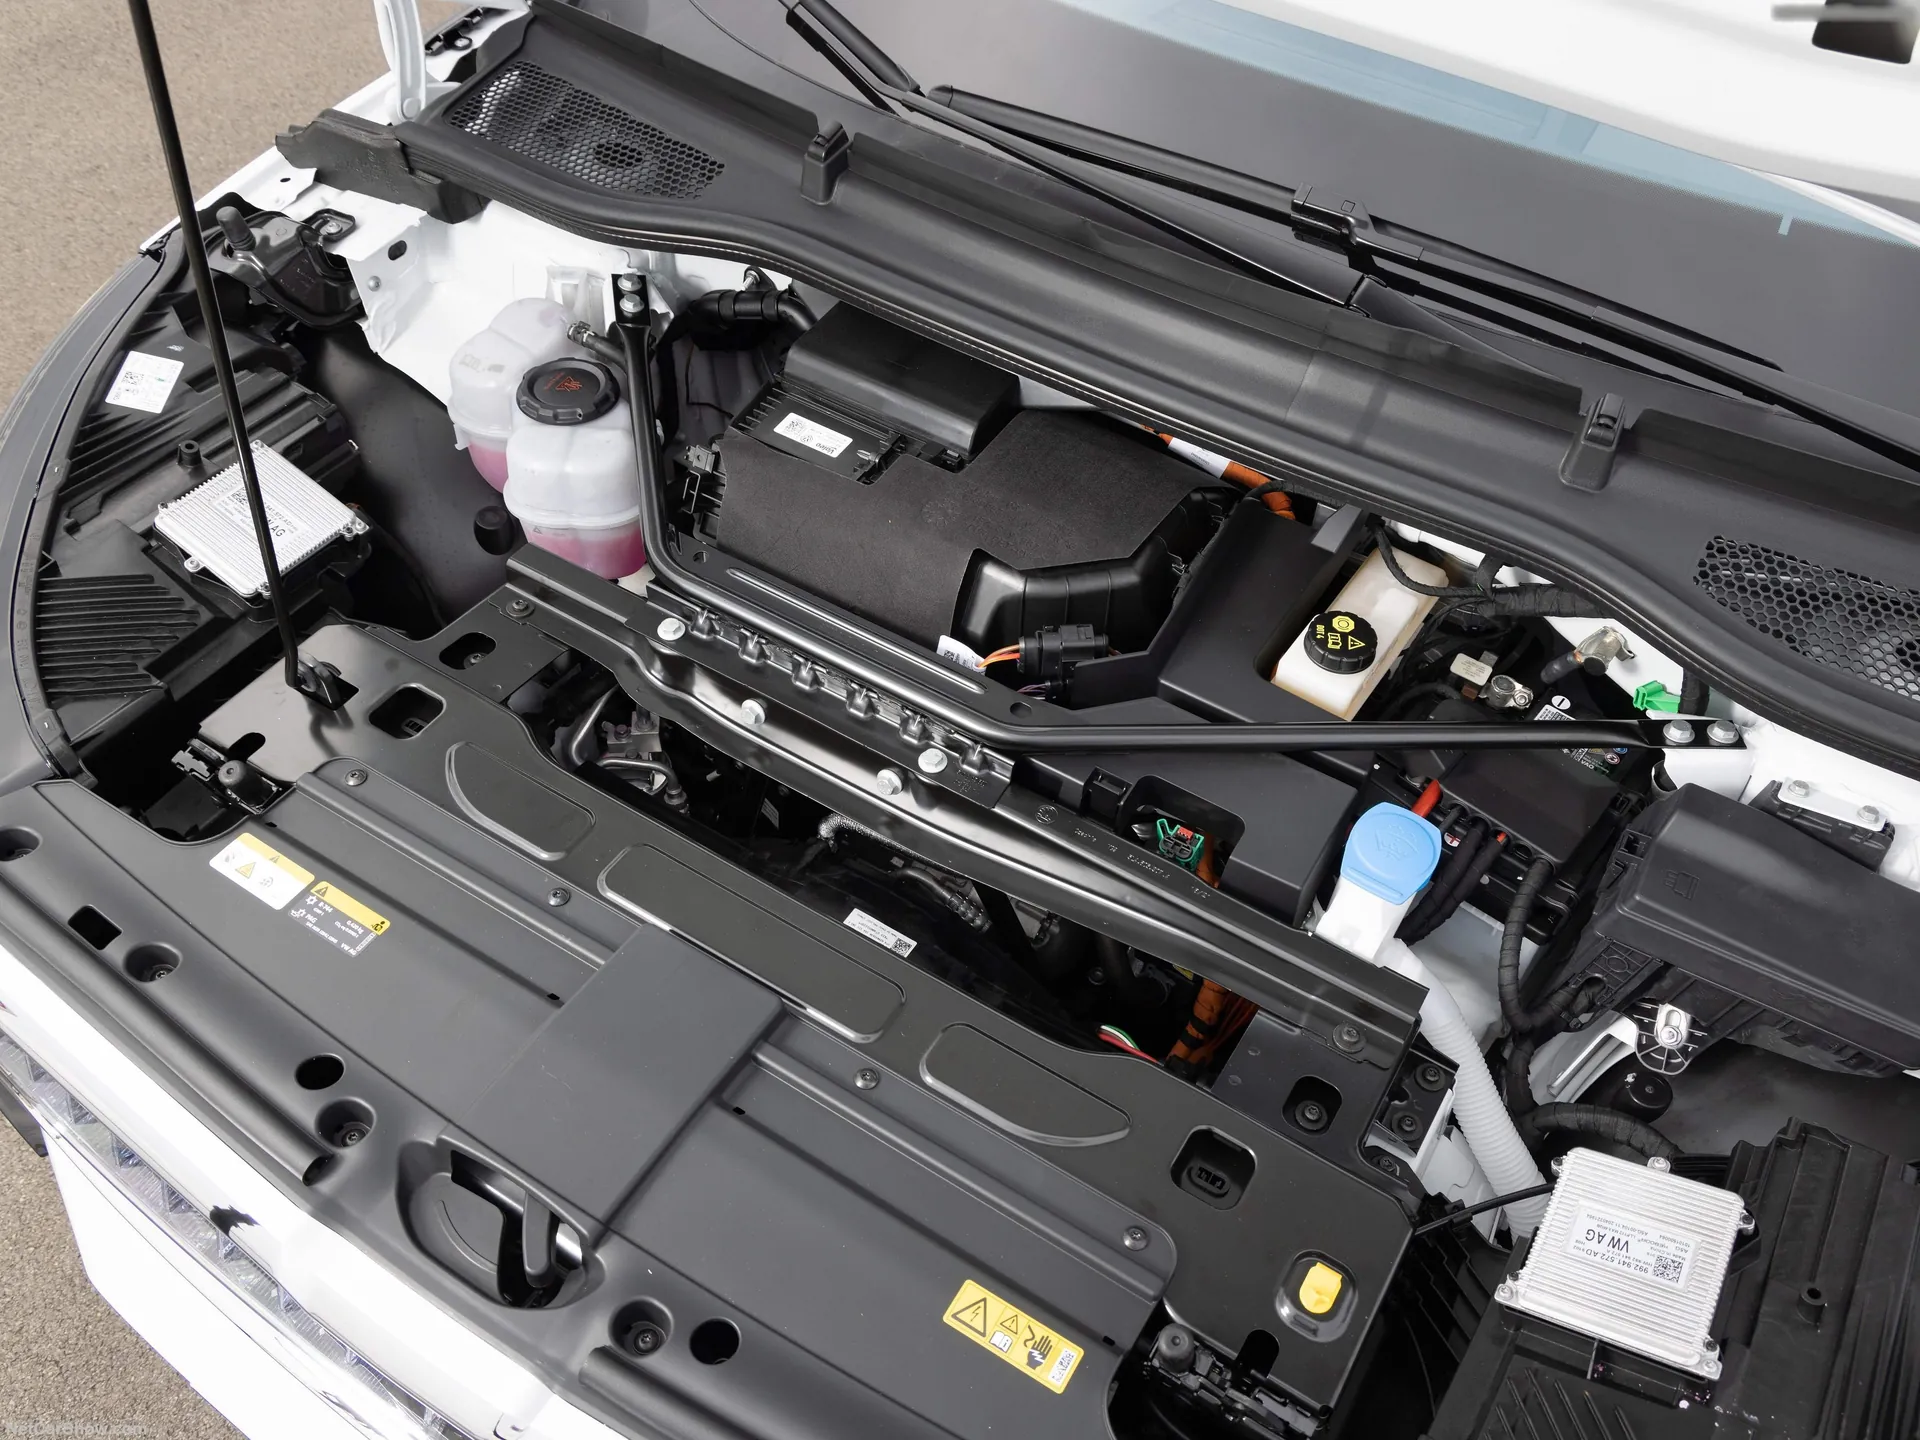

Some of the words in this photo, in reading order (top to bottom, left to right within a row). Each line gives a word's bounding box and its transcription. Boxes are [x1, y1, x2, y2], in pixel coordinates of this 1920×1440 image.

[270, 525, 286, 537] AG
[1316, 624, 1325, 635] DOT
[318, 902, 333, 912] R-744
[305, 913, 318, 923] PAG
[341, 942, 350, 951] VW
[348, 948, 357, 956] AG
[1585, 1229, 1607, 1244] AG
[1607, 1236, 1630, 1253] VW
[1650, 1246, 1665, 1256] China
[1585, 1248, 1649, 1274] 992.941.572.AD
[1672, 1253, 1686, 1261] Made
